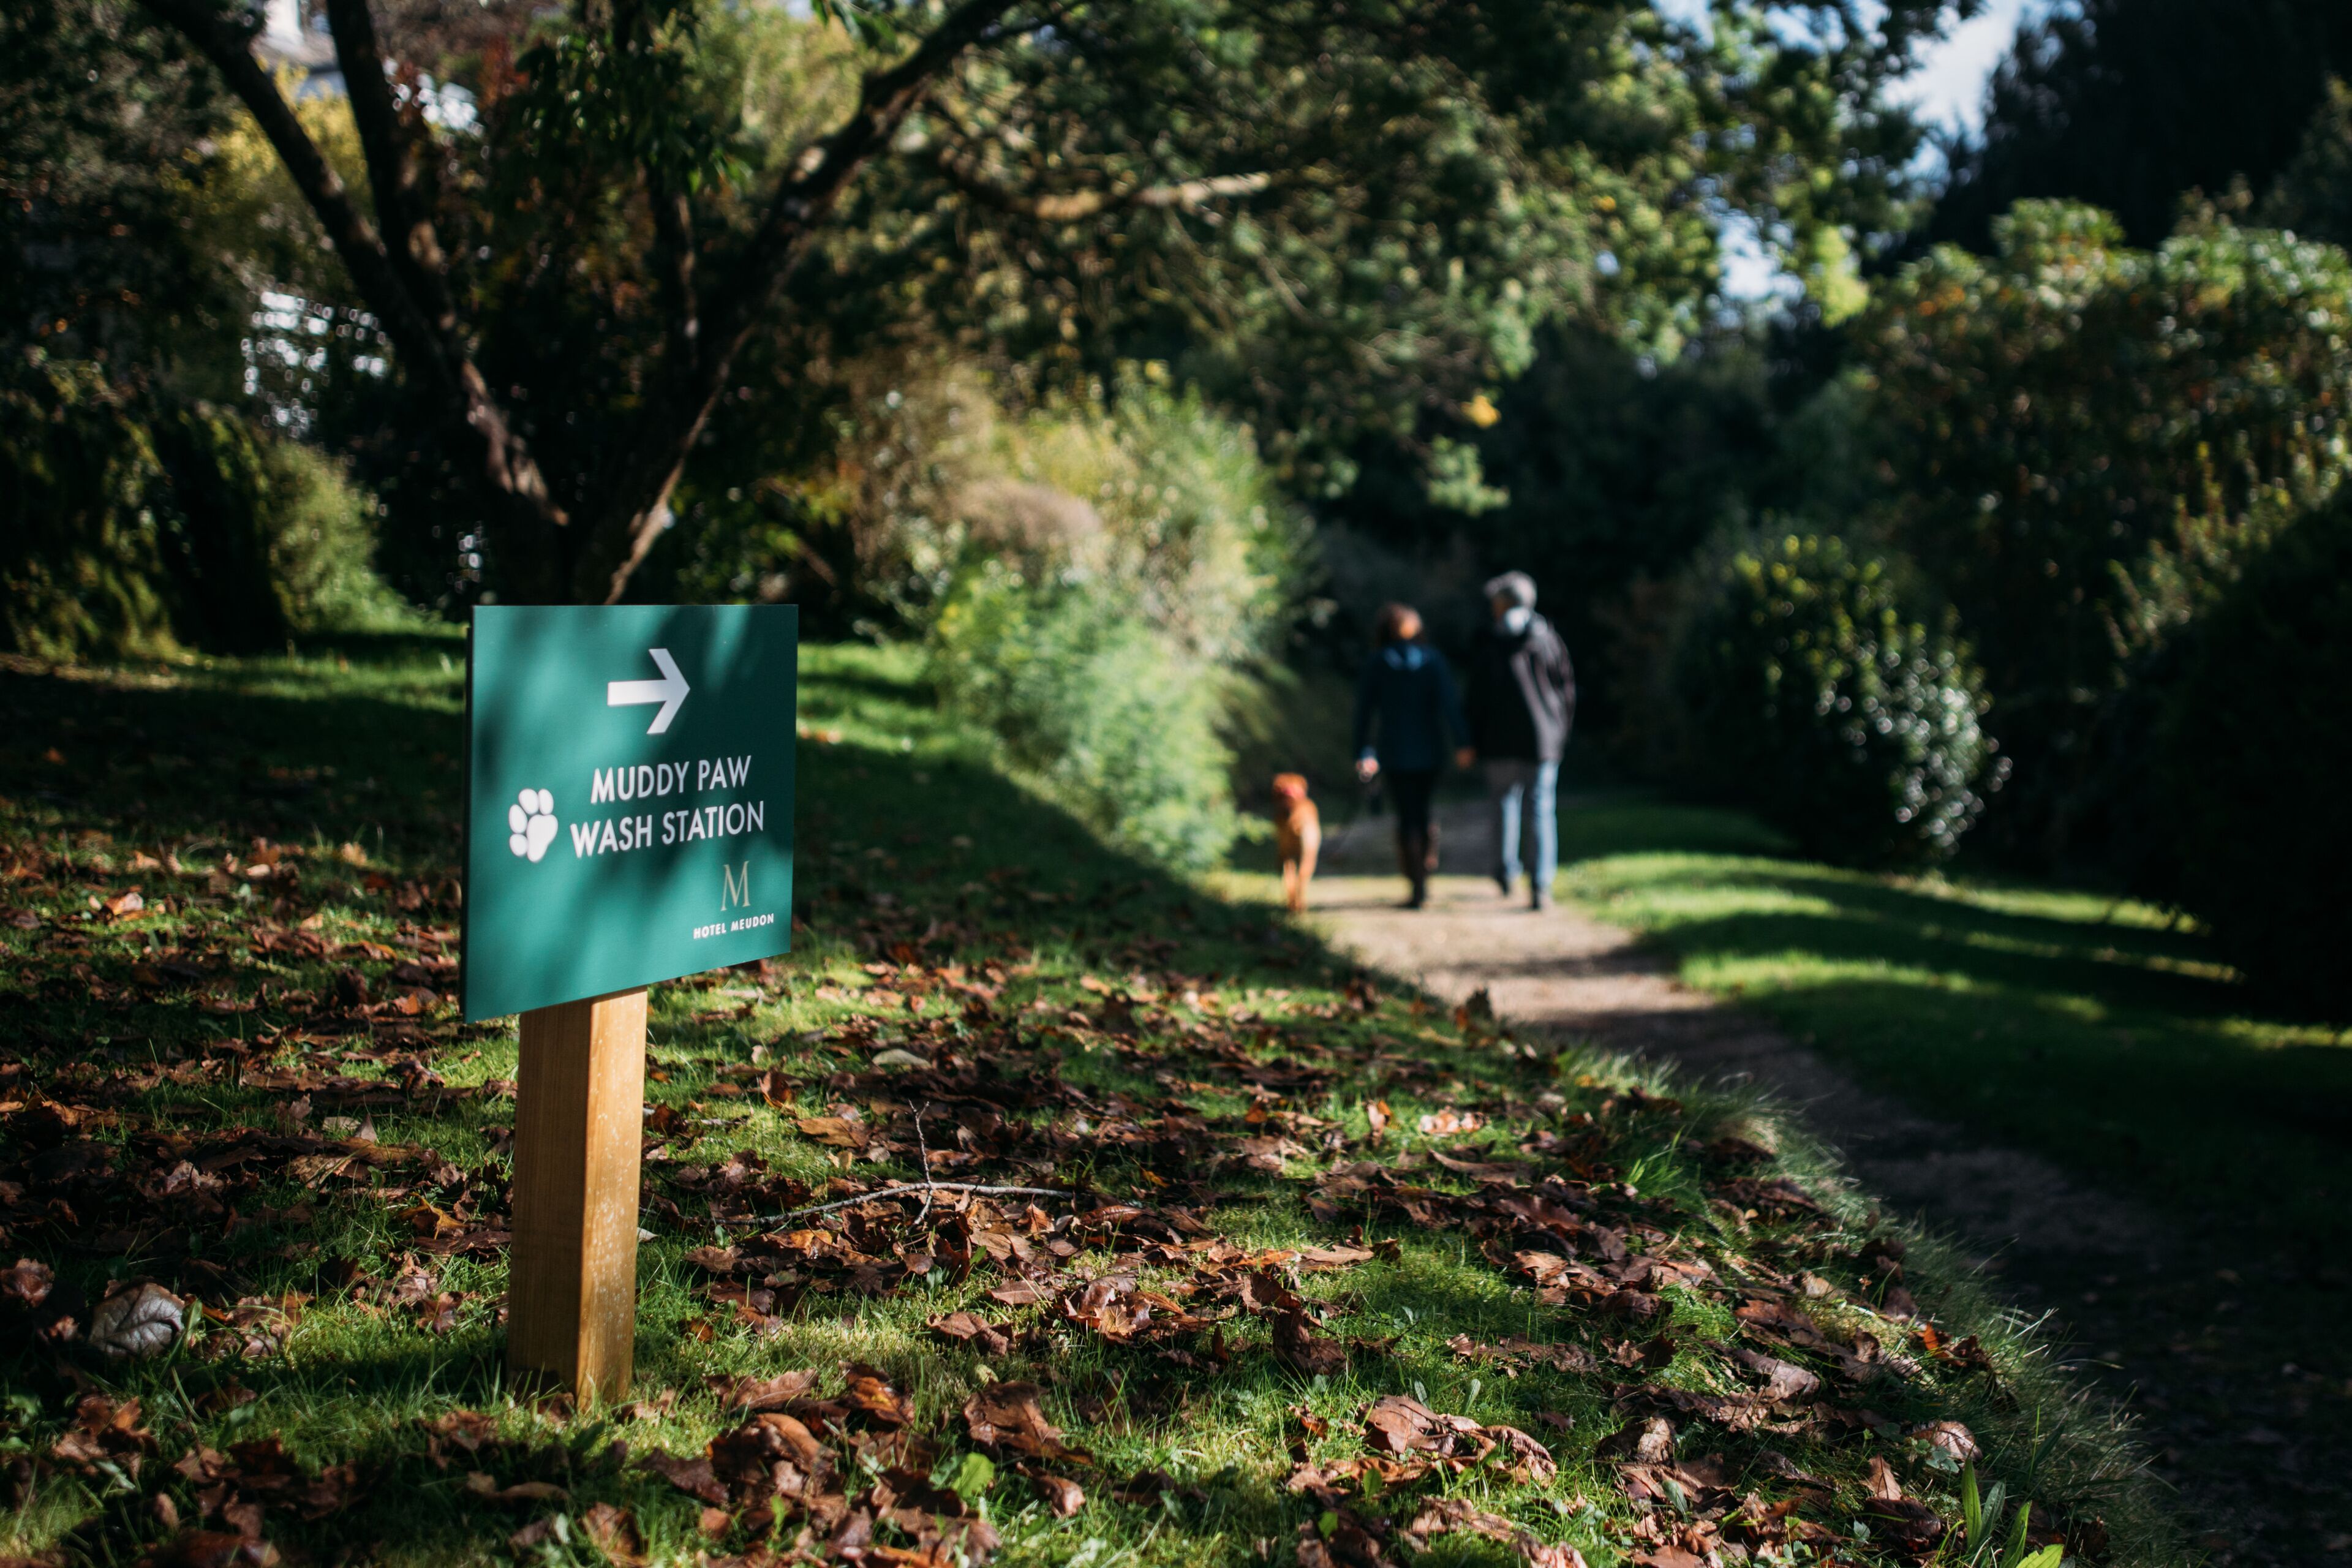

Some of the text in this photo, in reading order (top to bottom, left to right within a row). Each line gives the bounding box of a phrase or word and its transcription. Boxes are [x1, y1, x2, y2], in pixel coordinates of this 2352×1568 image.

[590, 755, 752, 804] MUDDY PAW
[570, 801, 764, 858] WASH STATION
[720, 861, 750, 911] M
[693, 913, 774, 940] HOTEL MEUDON
